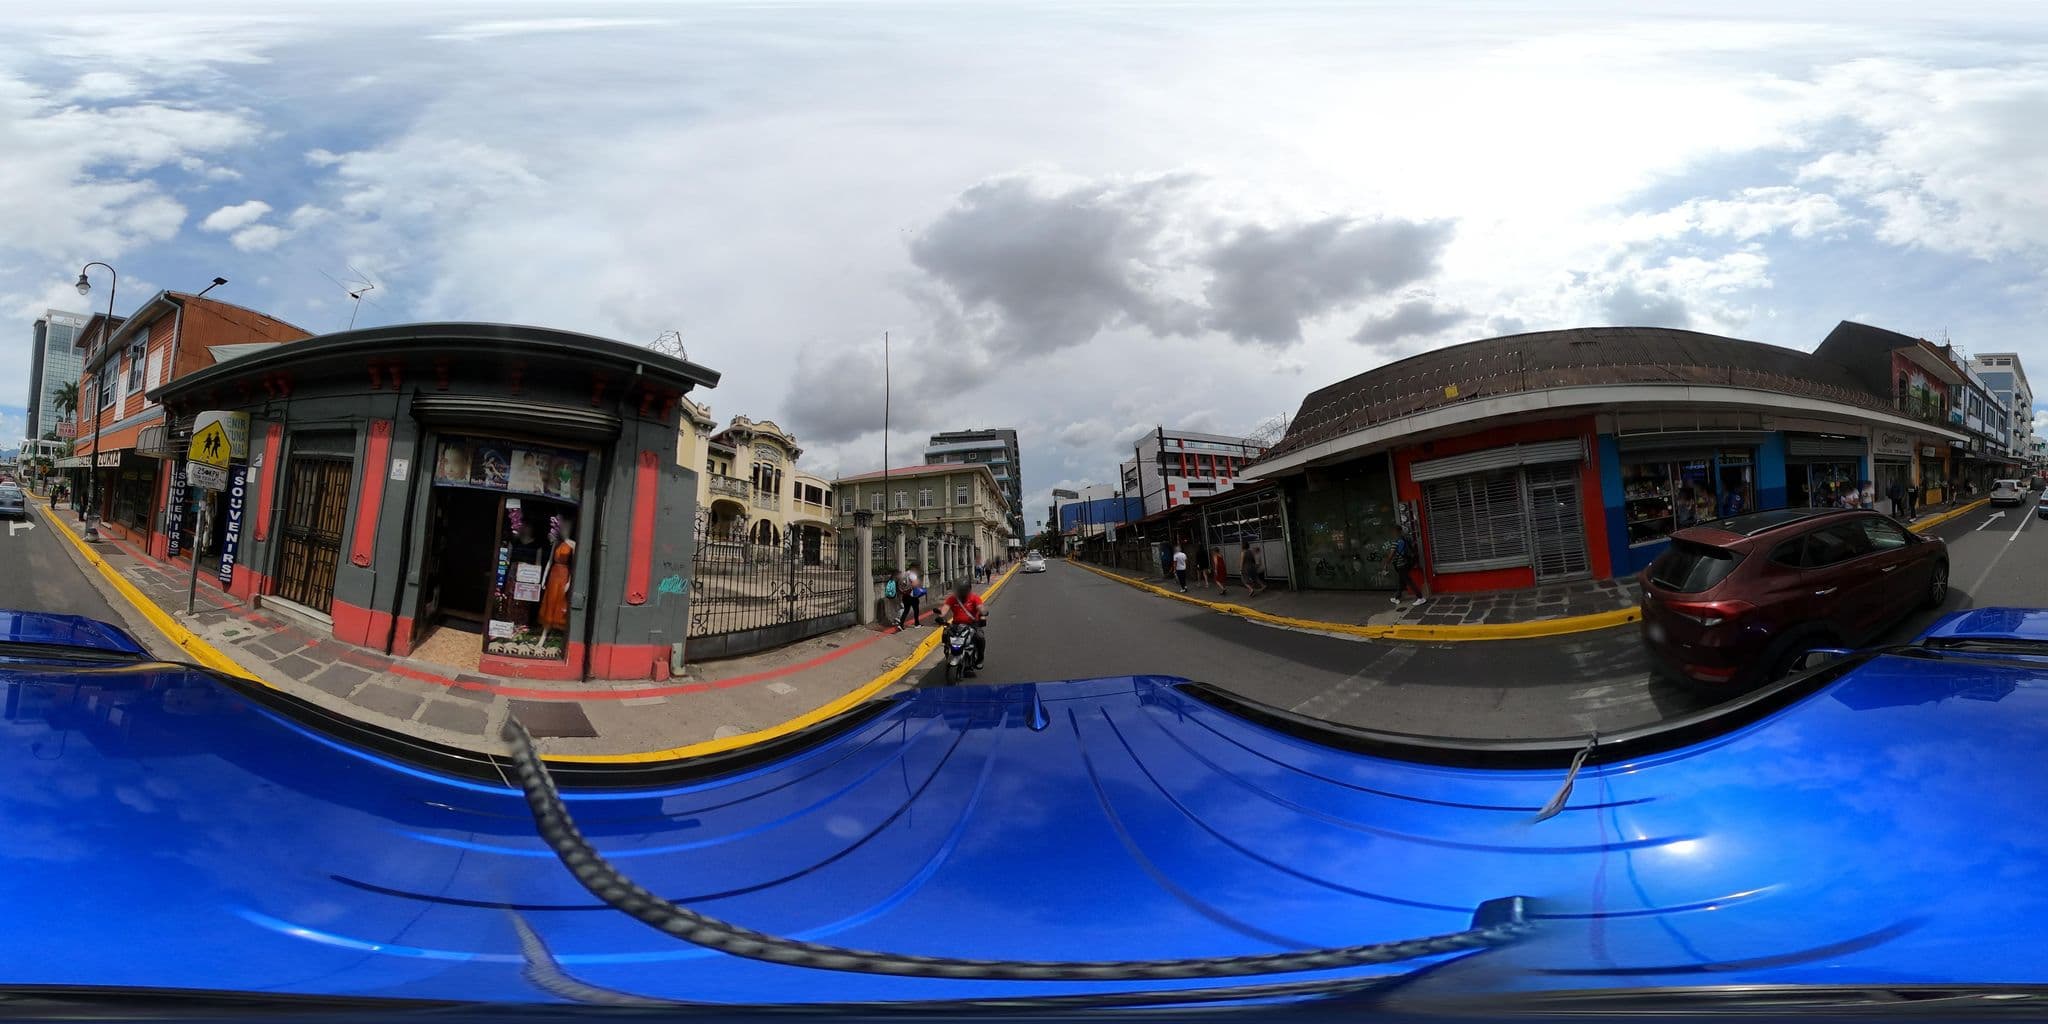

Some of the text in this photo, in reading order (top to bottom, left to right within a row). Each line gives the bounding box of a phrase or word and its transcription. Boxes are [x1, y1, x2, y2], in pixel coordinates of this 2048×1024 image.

[79, 450, 119, 466] GALER ZUKIA
[171, 471, 186, 549] SOUVENIRS
[221, 476, 245, 574] SOUVENIRS
